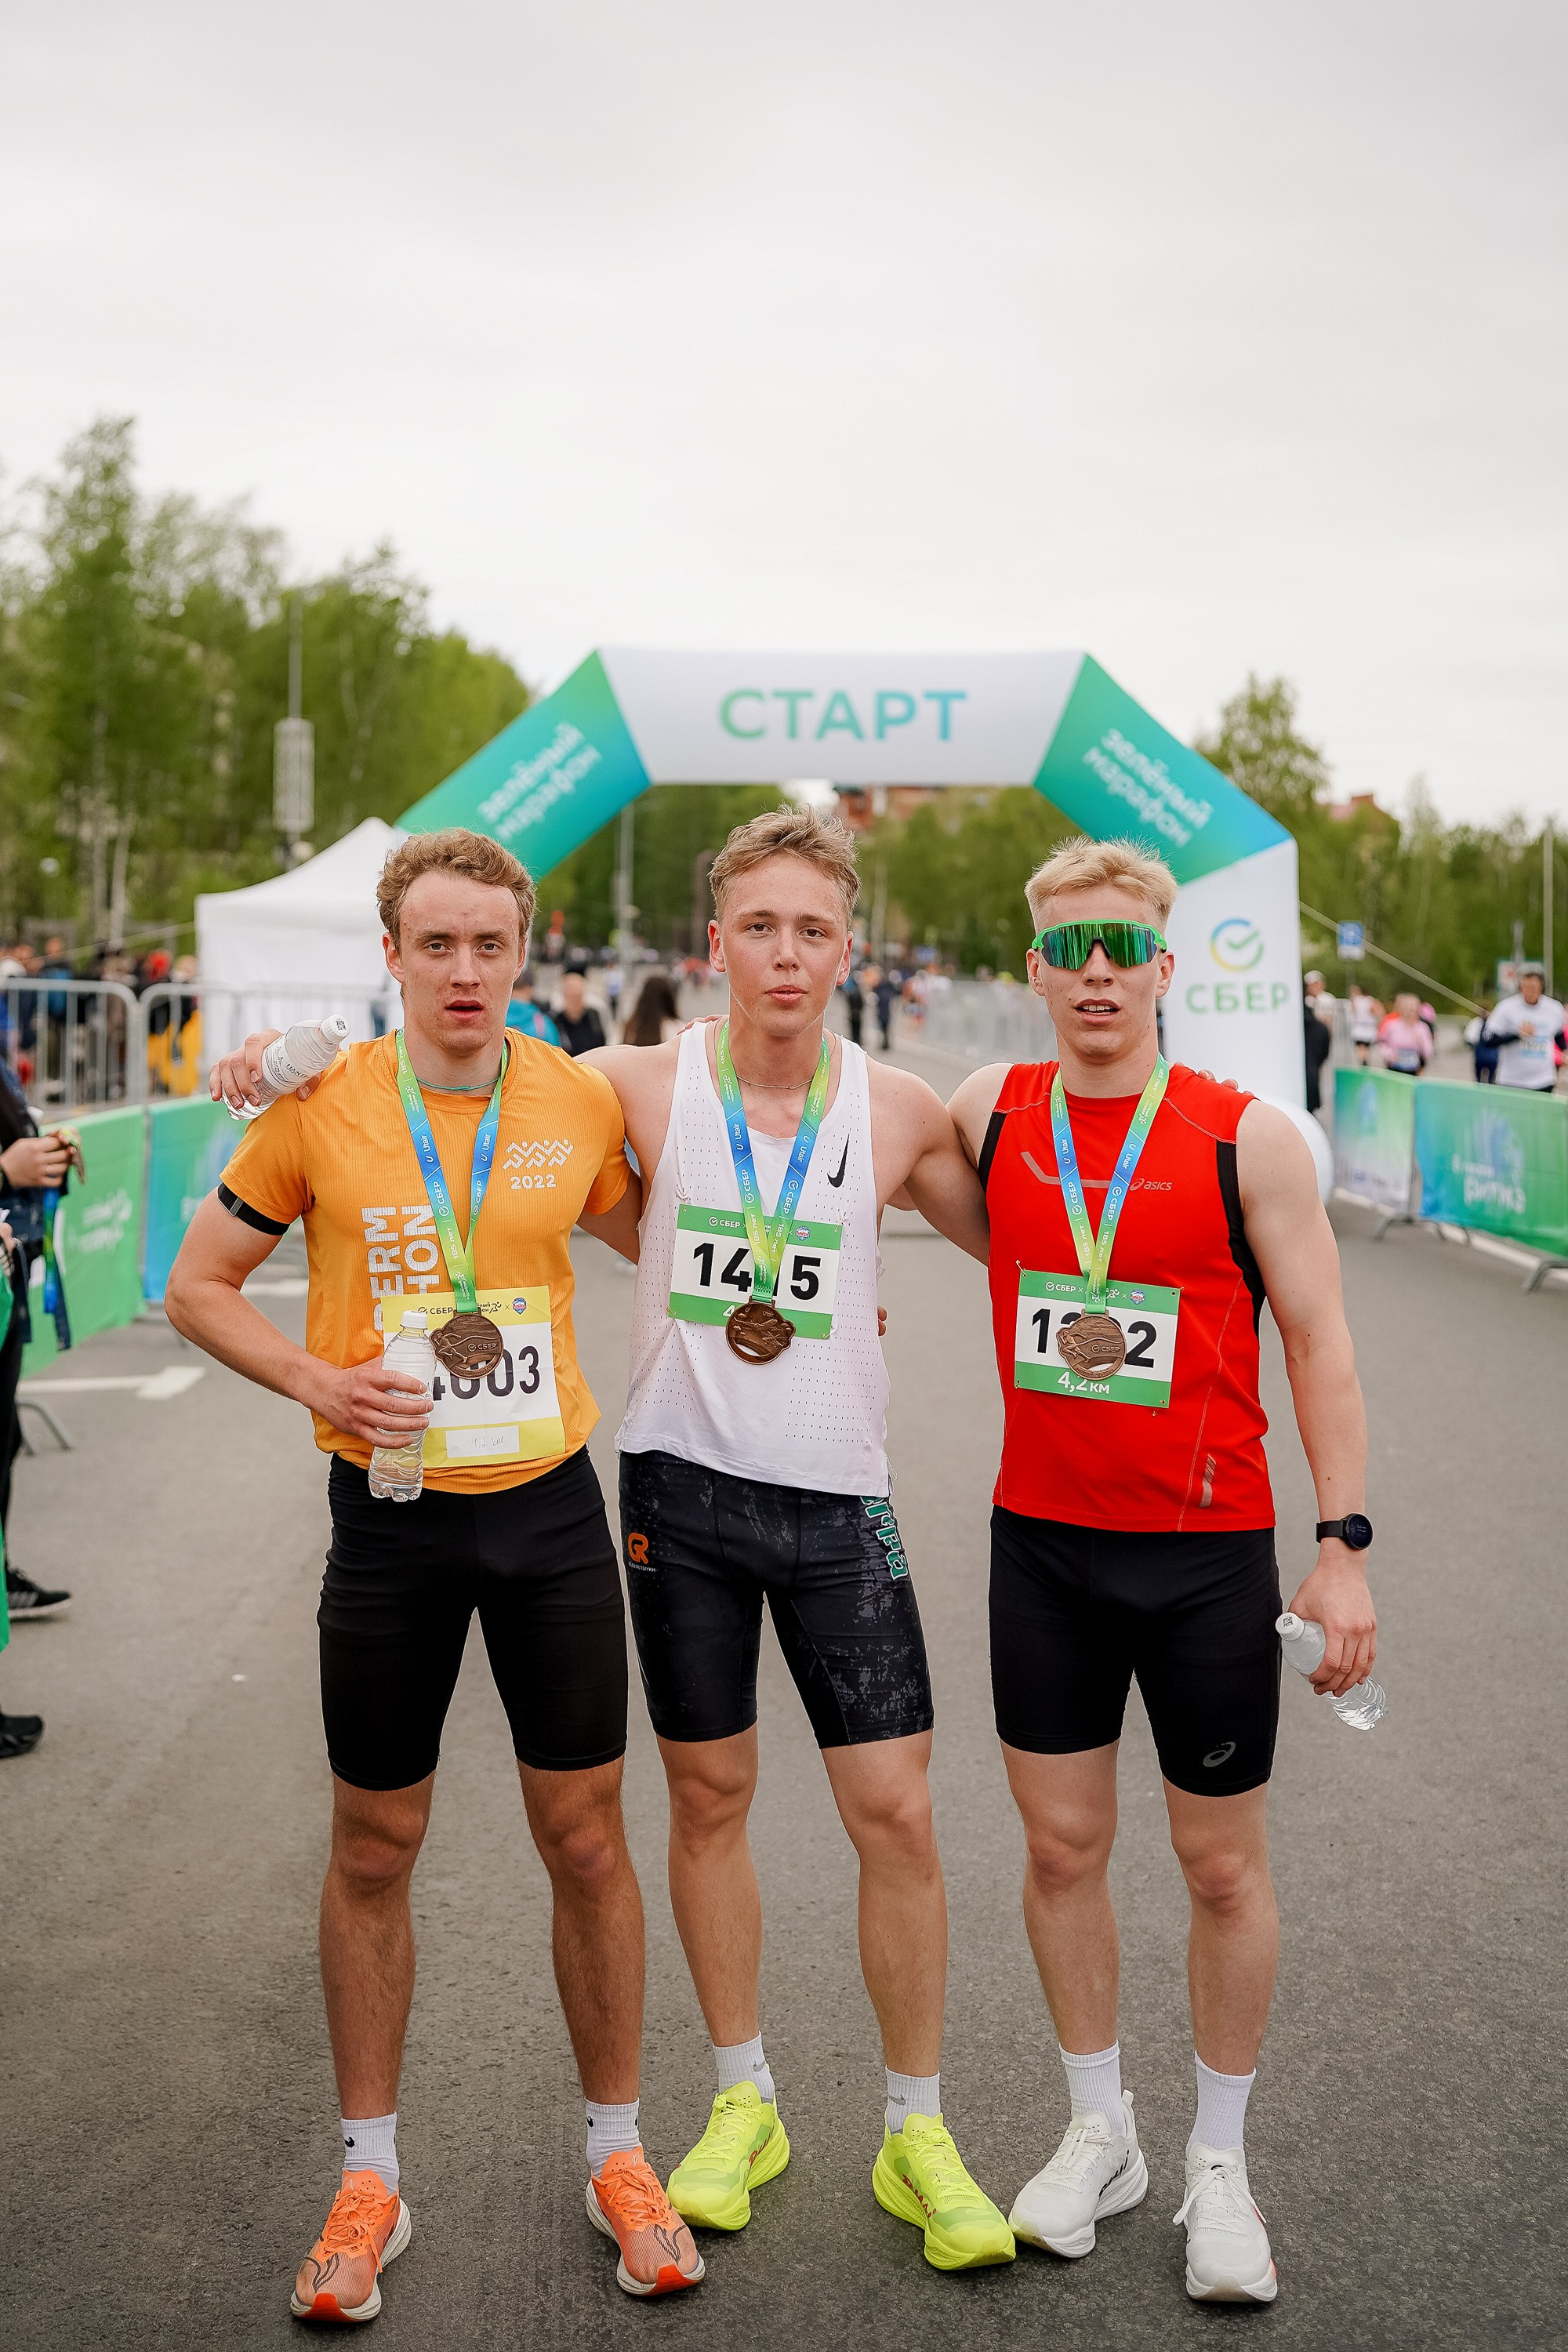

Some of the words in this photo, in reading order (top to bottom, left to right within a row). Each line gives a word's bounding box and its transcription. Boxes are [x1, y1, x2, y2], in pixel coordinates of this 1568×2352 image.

[719, 688, 967, 740] СТАРТ
[1185, 982, 1290, 1014] СБЕР
[733, 1123, 742, 1140] Utair
[421, 1134, 430, 1152] Utair
[482, 1134, 491, 1150] Utair
[797, 1145, 808, 1163] Utair
[1122, 1153, 1133, 1170] Utair
[510, 1174, 557, 1190] 2022
[741, 1169, 751, 1192] СБЕР
[1143, 1181, 1173, 1191] asics
[433, 1181, 445, 1204] СБЕР
[1068, 1181, 1079, 1203] СБЕР
[783, 1191, 794, 1214] СБЕР
[1108, 1198, 1118, 1221] СБЕР
[719, 1220, 741, 1229] СБЕР
[775, 1223, 784, 1238] 185
[1079, 1225, 1087, 1240] лет
[401, 1205, 440, 1294] HON
[450, 1243, 459, 1259] 185
[1082, 1241, 1091, 1256] 185
[361, 1206, 405, 1331] ERM
[693, 1243, 822, 1301] 145
[1055, 1283, 1076, 1292] СБЕР
[1031, 1308, 1158, 1369] 12
